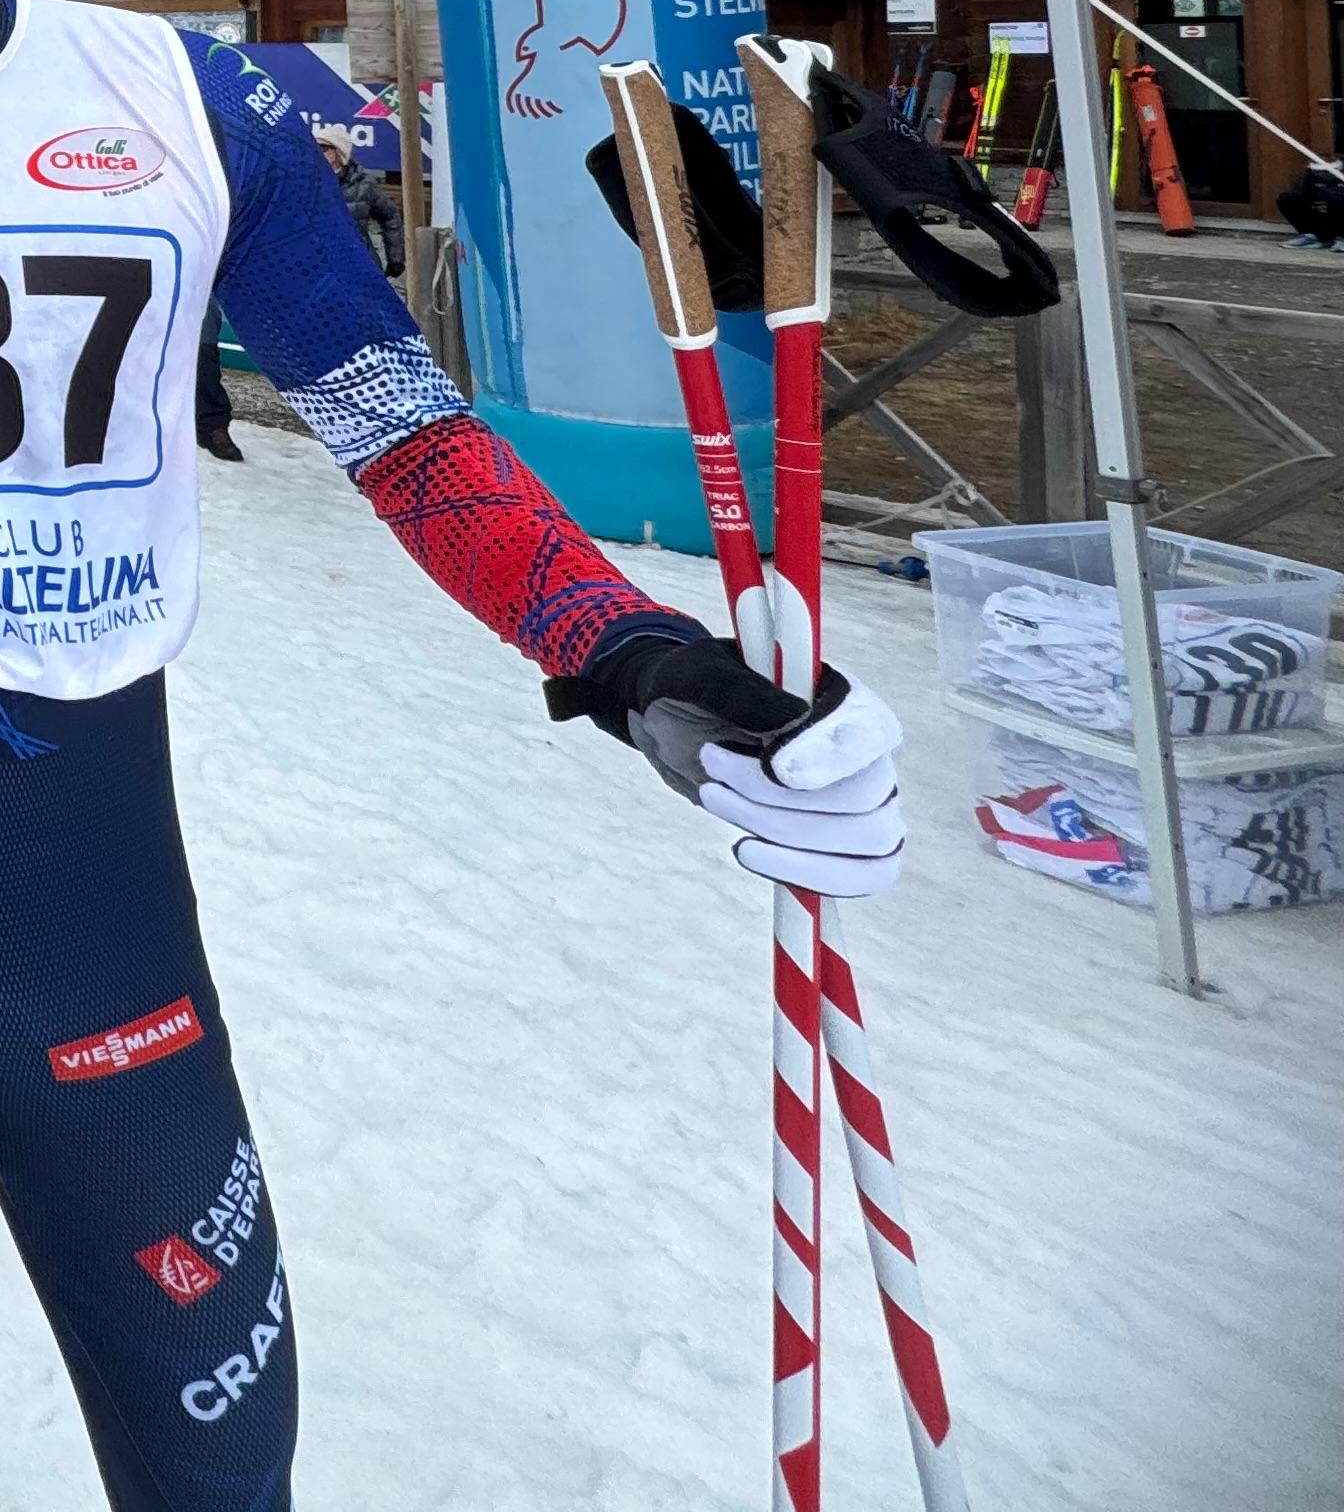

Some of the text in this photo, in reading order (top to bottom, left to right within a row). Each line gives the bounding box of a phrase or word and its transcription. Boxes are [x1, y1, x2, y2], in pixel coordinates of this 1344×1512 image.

[49, 151, 139, 171] Ottica
[706, 491, 740, 501] TRIAC
[191, 1136, 251, 1246] CAISSE
